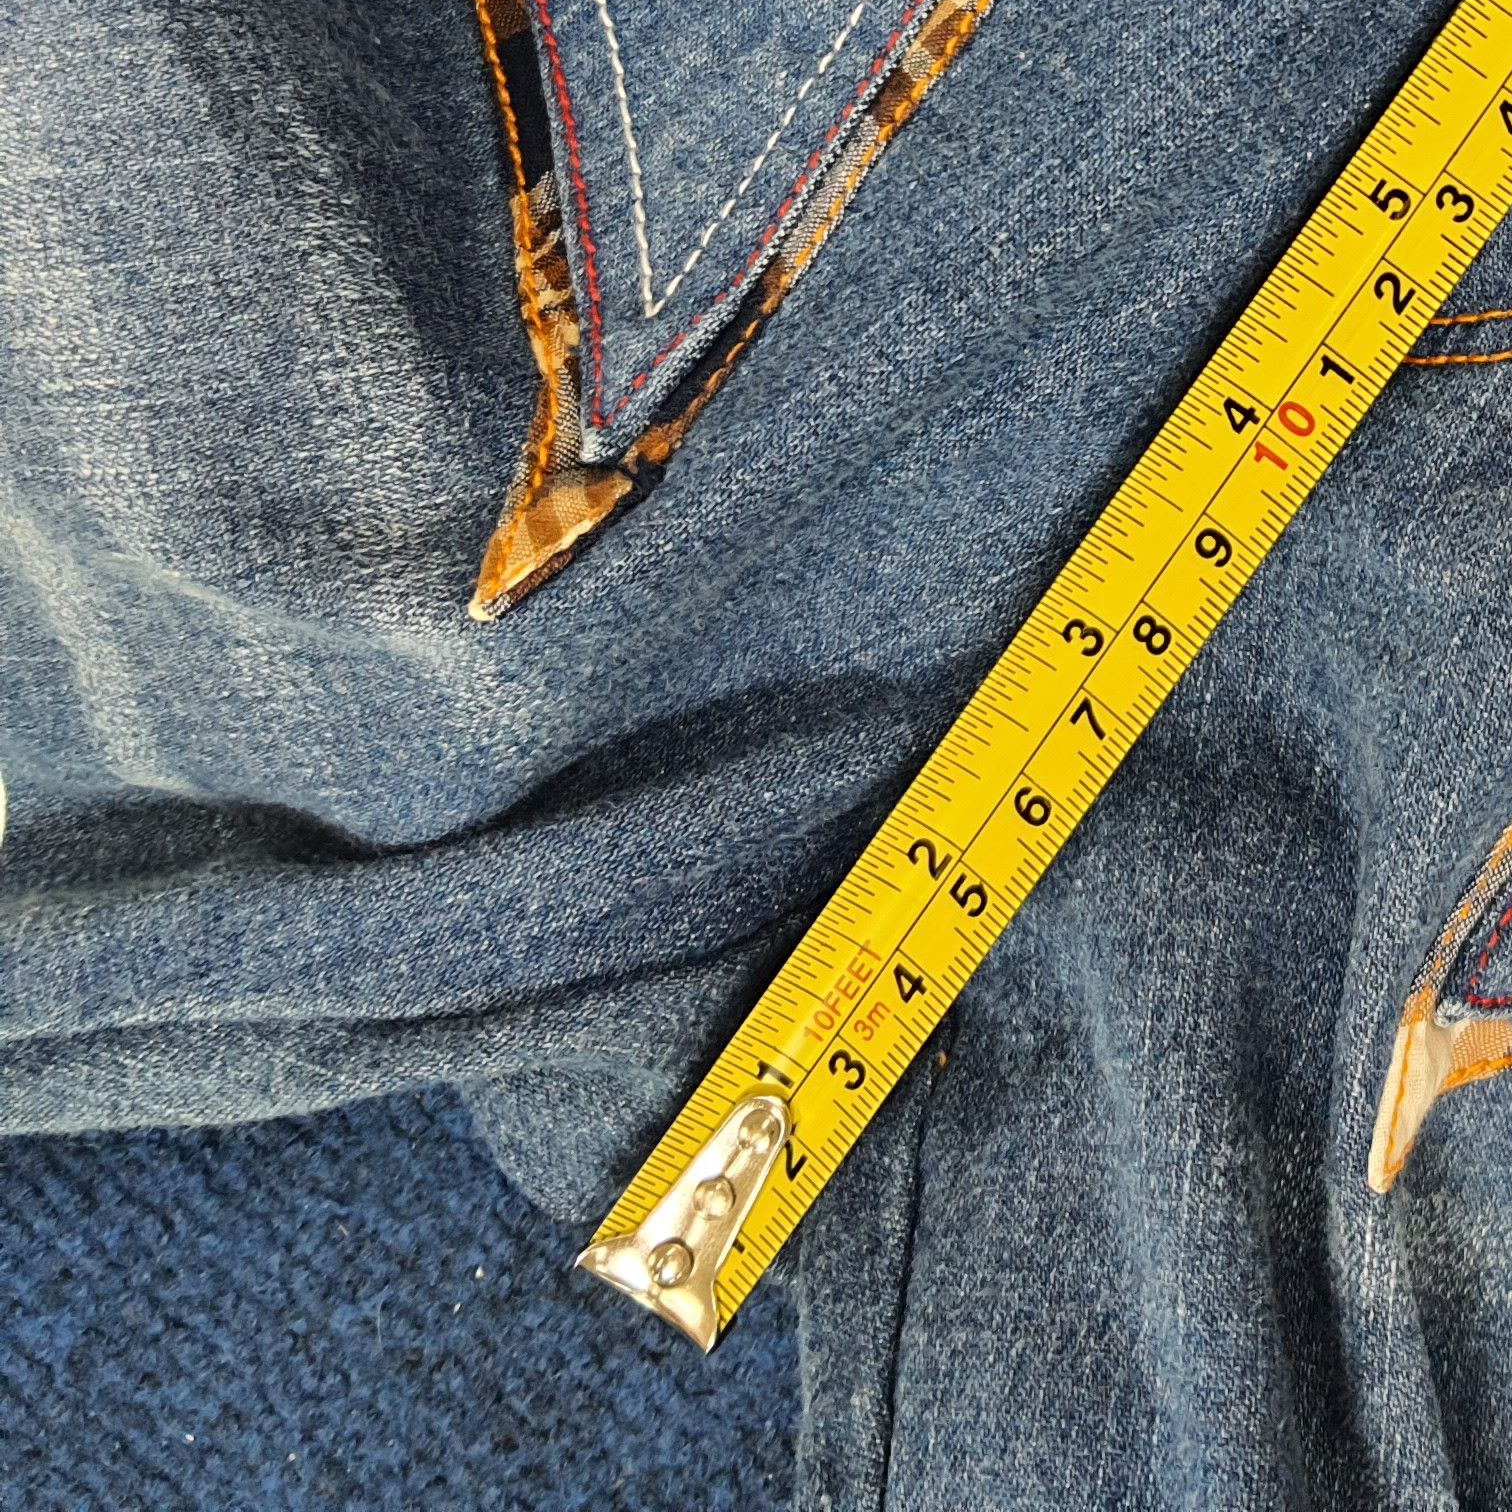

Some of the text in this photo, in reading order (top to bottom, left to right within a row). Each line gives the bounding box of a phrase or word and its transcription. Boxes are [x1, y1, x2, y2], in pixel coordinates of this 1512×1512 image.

[1367, 178, 1412, 221] 5
[1434, 183, 1476, 224] 3
[1372, 271, 1417, 317] 2
[1318, 352, 1356, 386] 1
[1222, 396, 1262, 435] 4
[1253, 400, 1317, 472] 10
[1193, 527, 1233, 569] 9
[1061, 618, 1105, 658] 3
[1132, 614, 1173, 657] 8
[1069, 697, 1108, 742] 7
[1012, 786, 1053, 828] 6
[906, 837, 953, 881] 2
[948, 873, 990, 919] 5
[804, 938, 882, 1043] 10FEET
[893, 963, 929, 1005] 4
[853, 1000, 892, 1042] 3m
[756, 1059, 795, 1090] 1
[828, 1049, 868, 1091] 3
